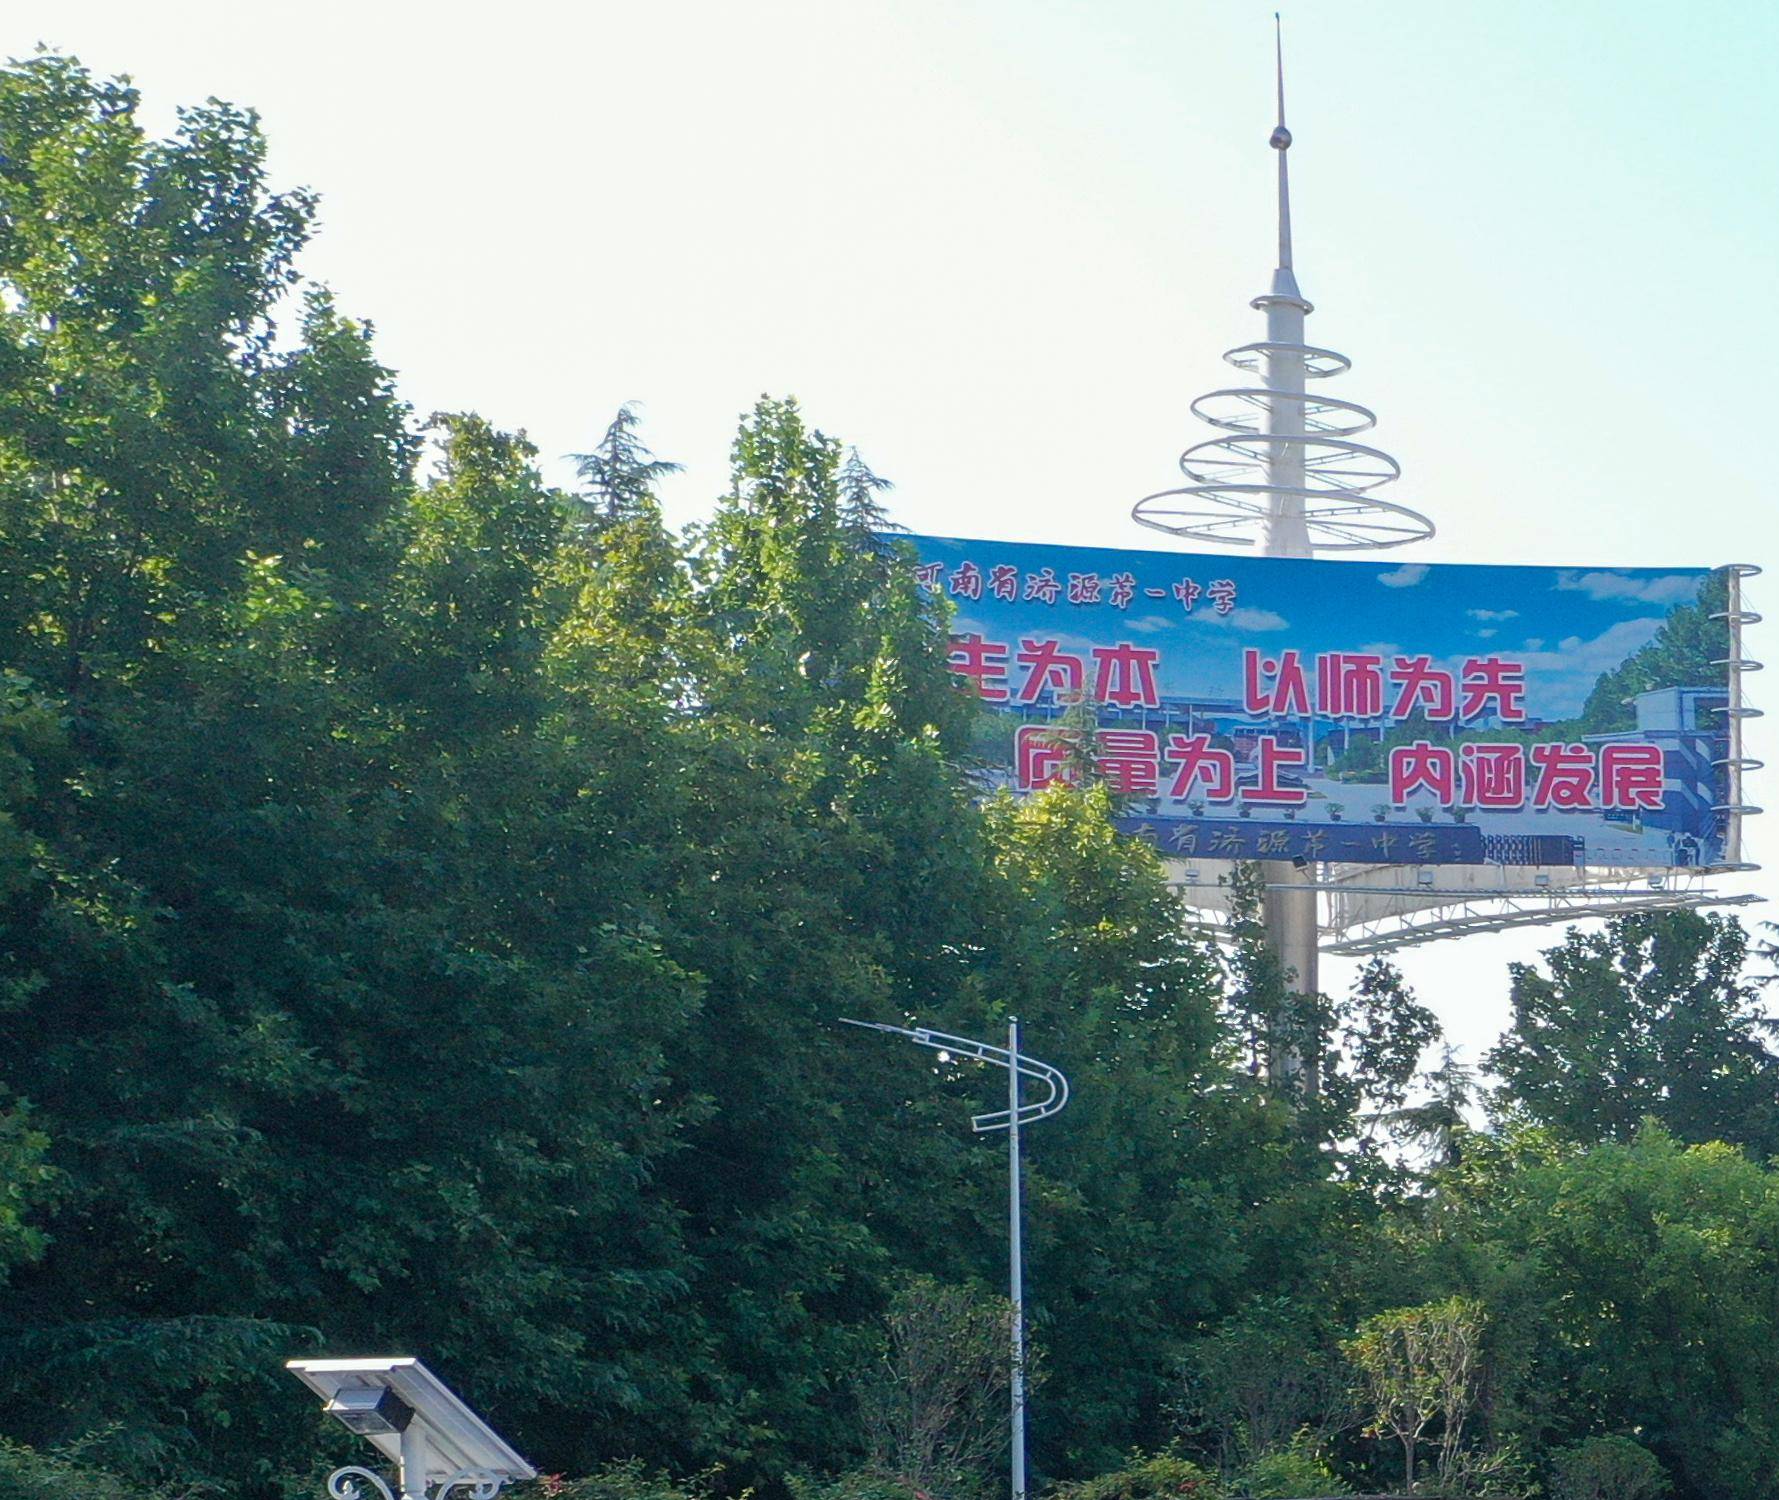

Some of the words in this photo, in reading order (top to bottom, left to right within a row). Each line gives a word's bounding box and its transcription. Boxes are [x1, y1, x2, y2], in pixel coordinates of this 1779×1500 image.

[1242, 647, 1526, 720] 以师为先
[1014, 726, 1307, 804] 质量为上
[1389, 740, 1665, 810] 内涵发展
